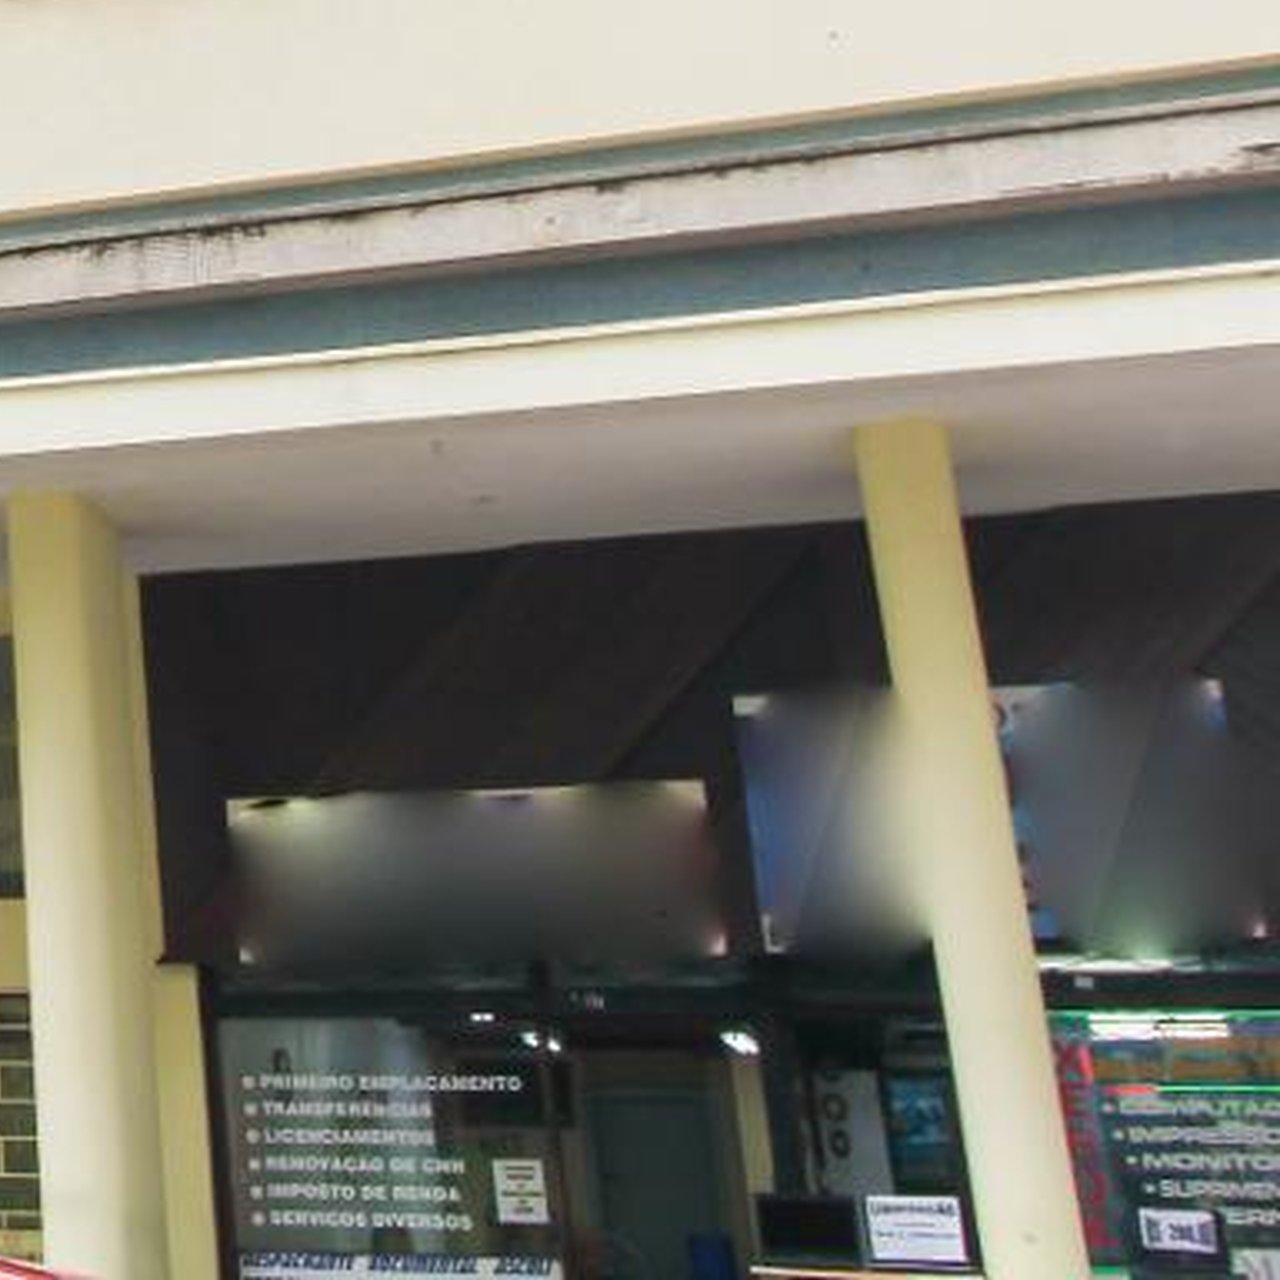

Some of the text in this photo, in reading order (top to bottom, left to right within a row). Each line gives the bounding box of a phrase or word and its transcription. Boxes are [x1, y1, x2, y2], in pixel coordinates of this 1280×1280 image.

[259, 1075, 523, 1092] PRIMEIRO EMPLACAMENTO
[264, 1129, 436, 1146] LICENCIAMENTOS
[389, 1157, 416, 1172] DE
[422, 1157, 465, 1174] CNH
[266, 1183, 462, 1202] IMPOSTO DE RENDA
[371, 1212, 473, 1231] DIVERSOS
